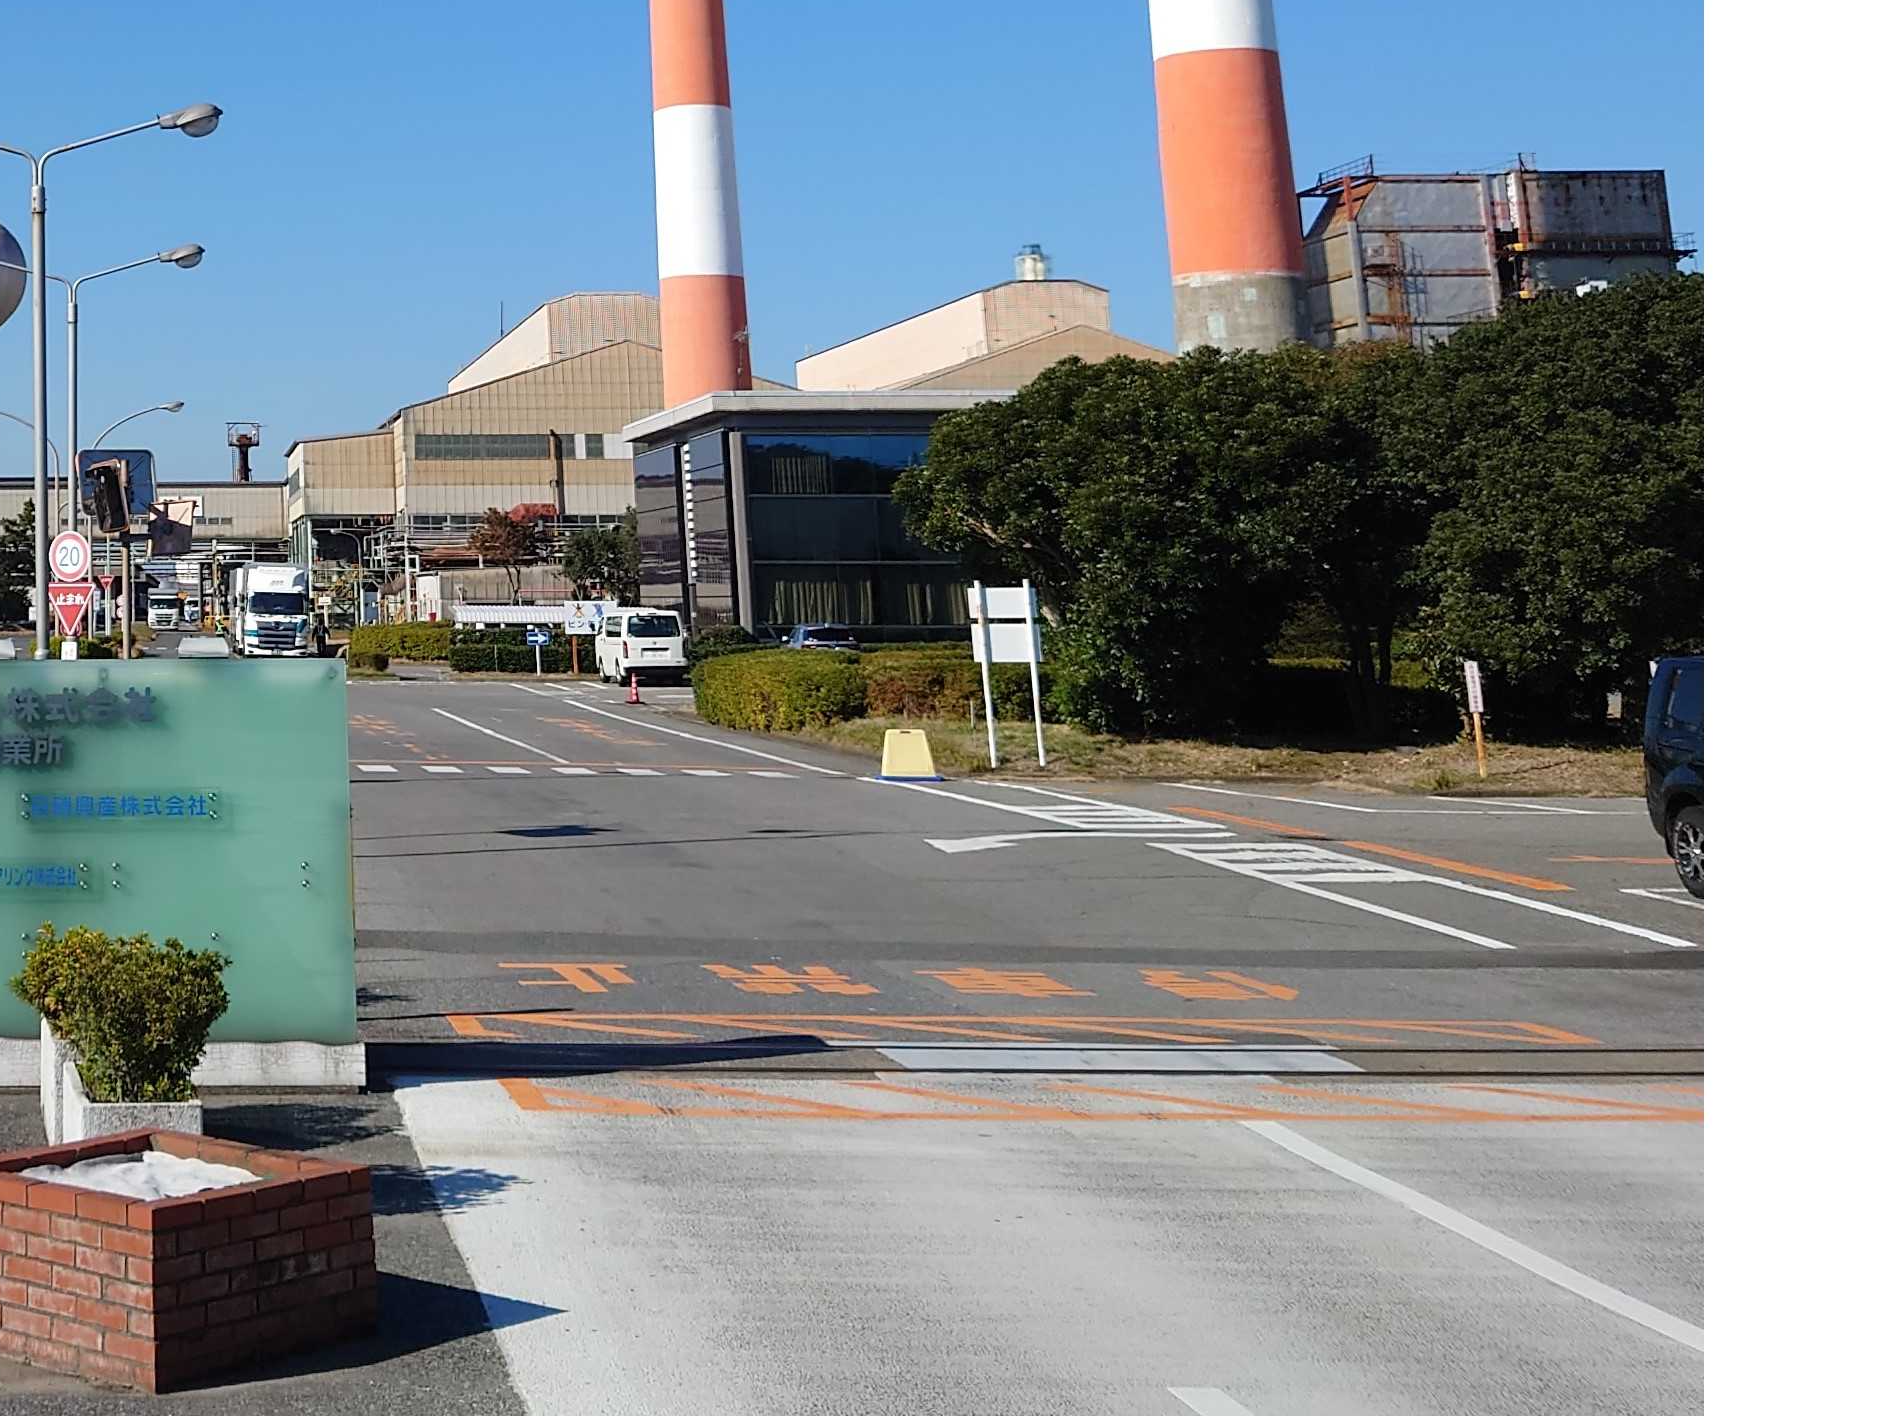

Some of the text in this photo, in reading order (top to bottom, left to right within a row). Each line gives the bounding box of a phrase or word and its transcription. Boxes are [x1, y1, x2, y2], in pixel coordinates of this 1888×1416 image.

[59, 546, 80, 566] 20
[57, 593, 85, 604] 止まれ
